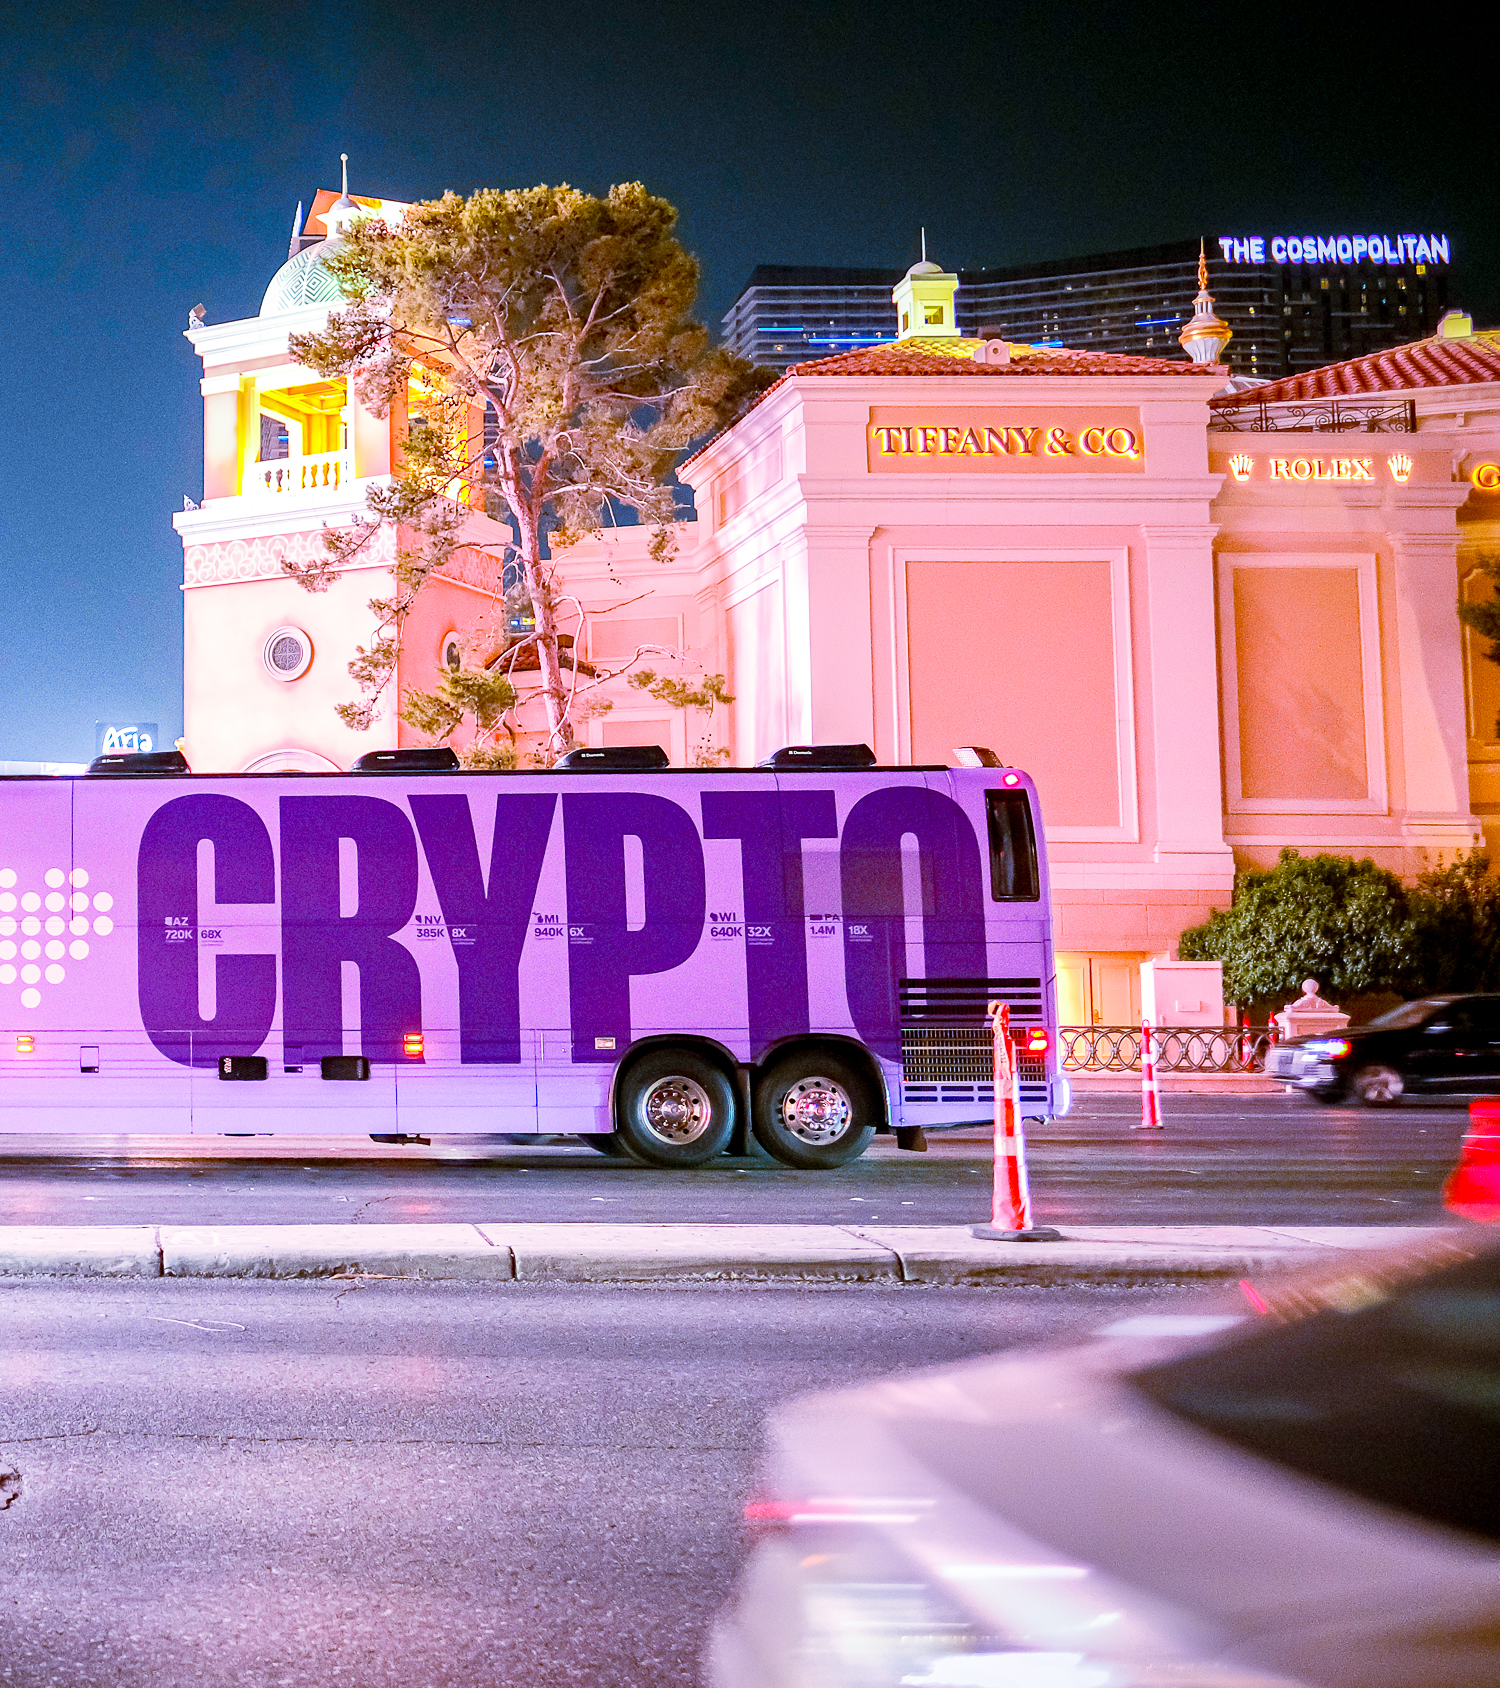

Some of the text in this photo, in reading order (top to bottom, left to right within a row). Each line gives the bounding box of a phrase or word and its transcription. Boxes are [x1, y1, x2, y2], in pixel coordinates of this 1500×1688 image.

[1219, 233, 1450, 265] THE COSMOPOLITAN
[872, 425, 1039, 457] TIFFANY
[1045, 427, 1074, 456] &
[1269, 458, 1375, 481] ROLEX
[172, 916, 189, 926] AZ
[424, 915, 441, 924] NV
[544, 914, 559, 923] MI
[719, 912, 736, 922] WI
[824, 913, 840, 921] PA
[137, 785, 990, 1069] CRYPTO
[534, 927, 584, 937] 940K 6X
[710, 926, 771, 937] 640K 32X
[810, 925, 868, 935] 1.4M 18X
[164, 929, 222, 939] 720K 68X
[416, 928, 466, 938] 385K 8X
